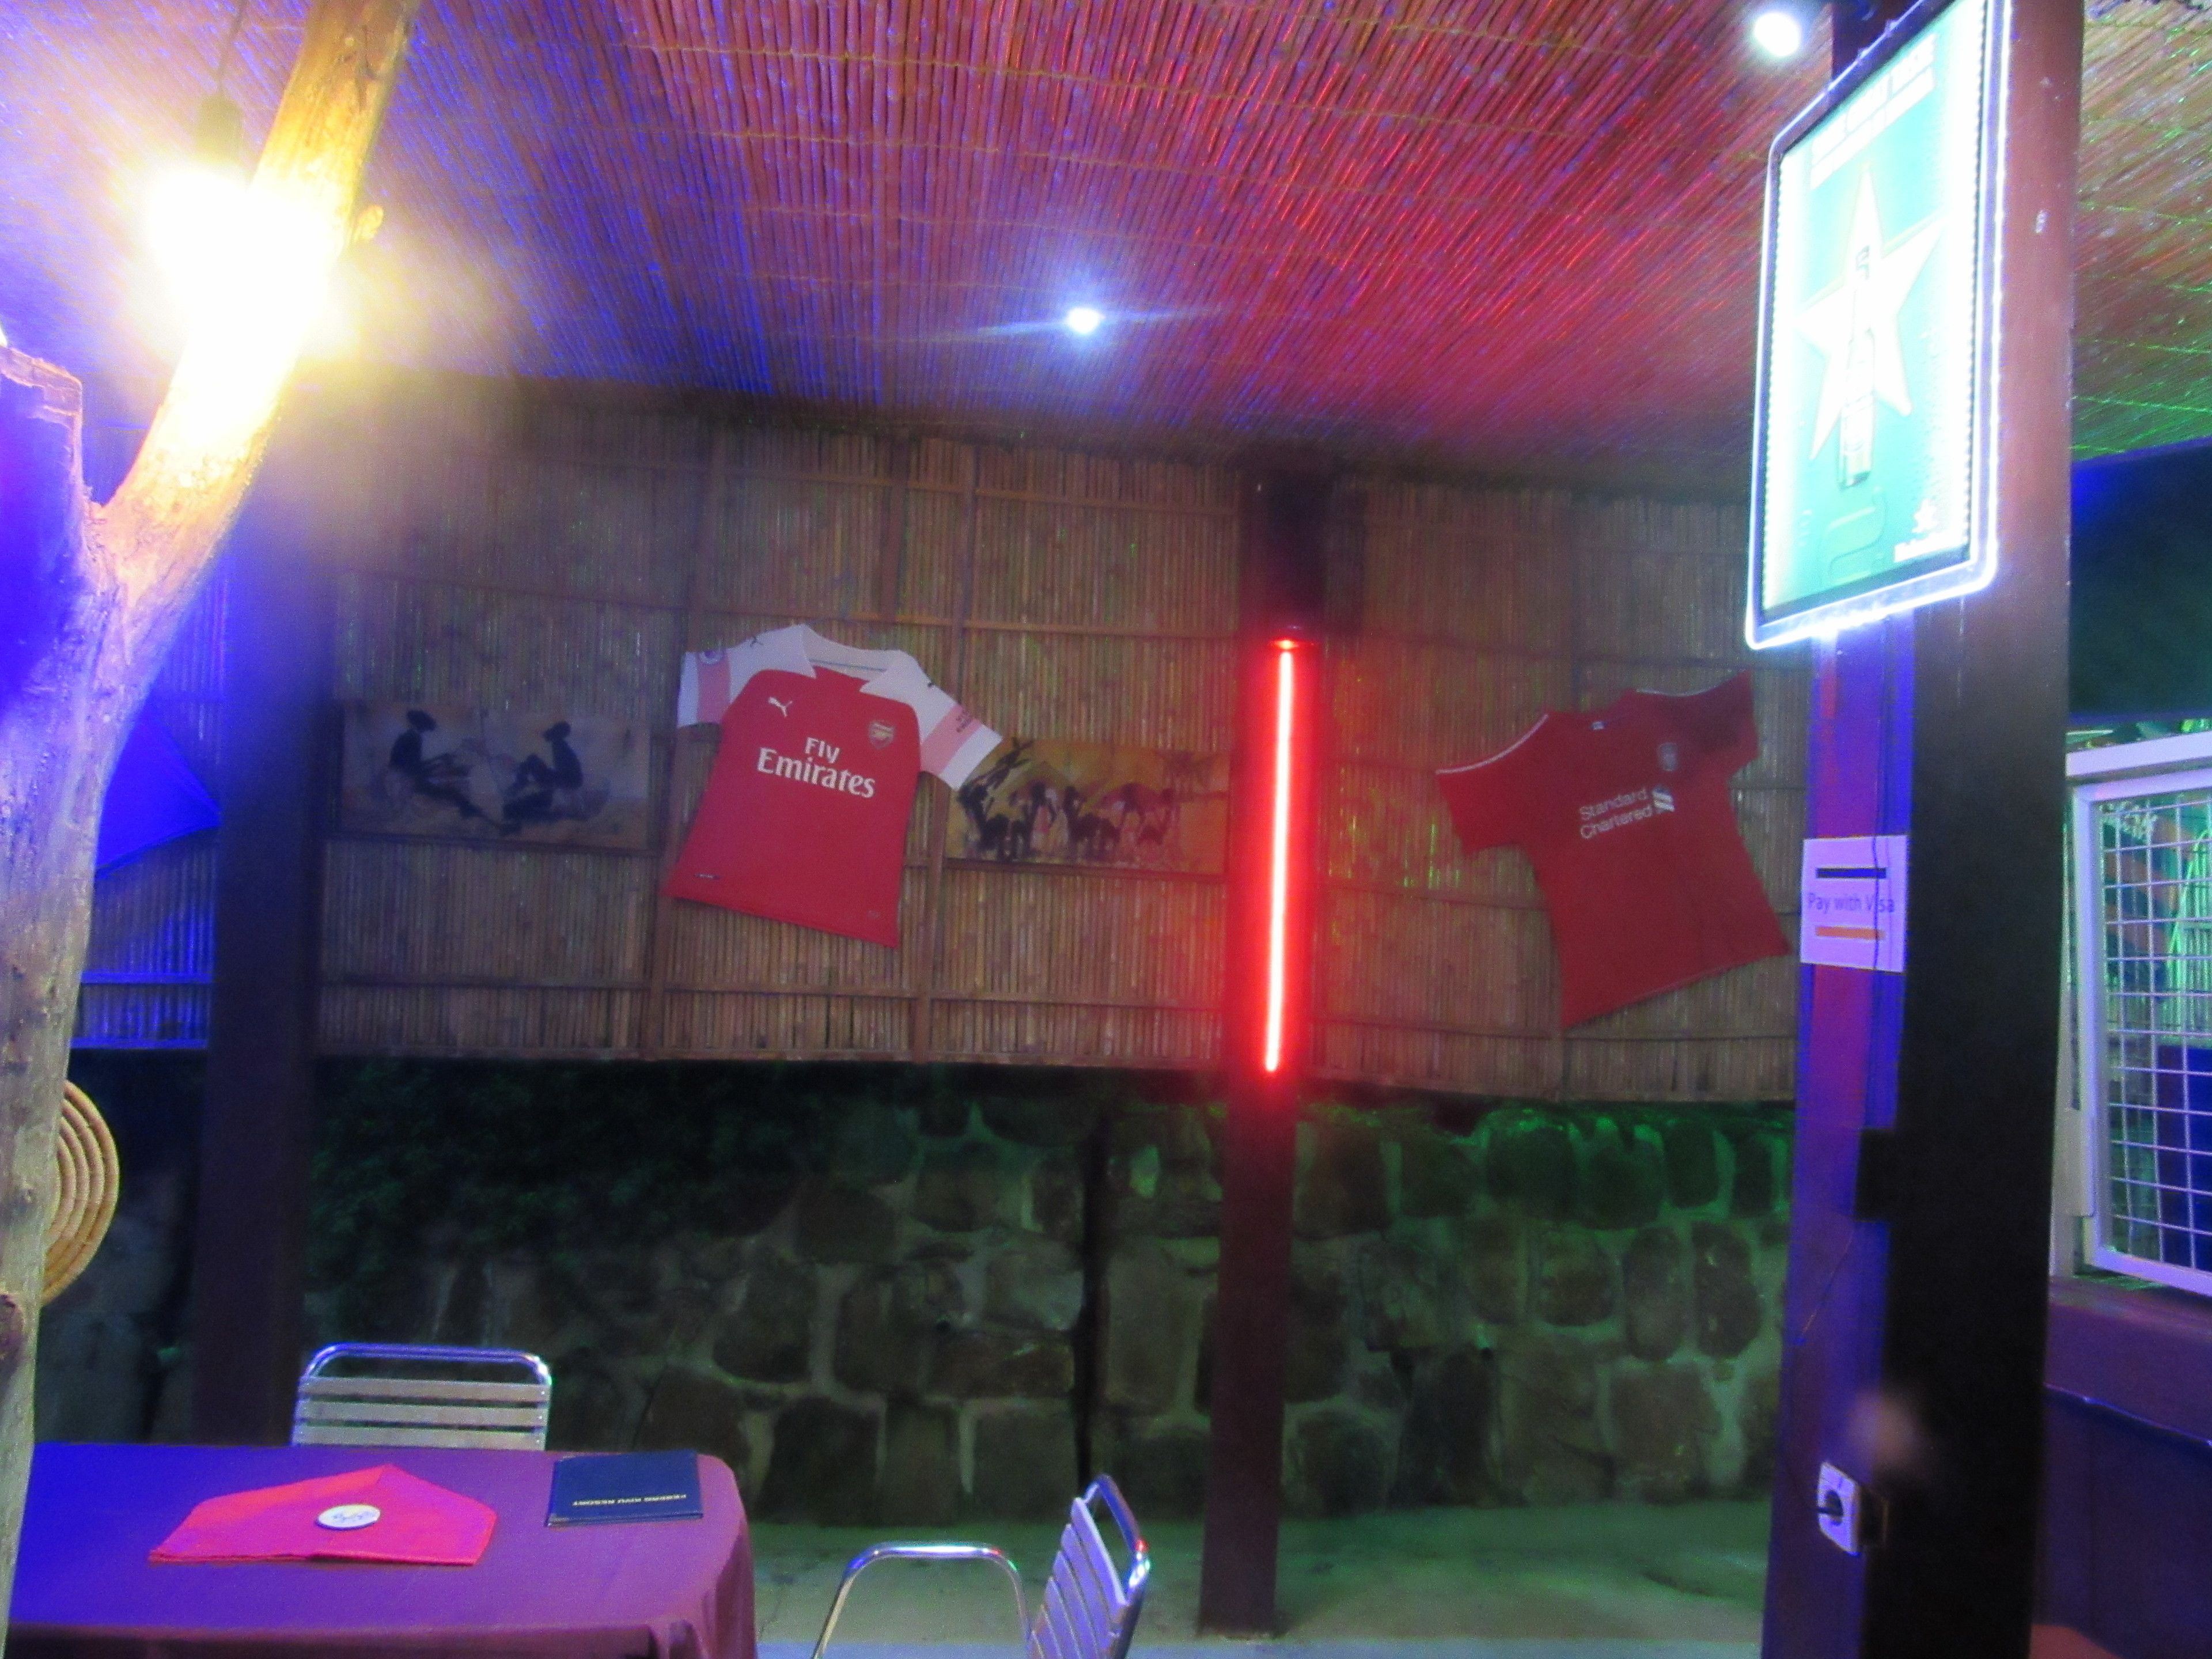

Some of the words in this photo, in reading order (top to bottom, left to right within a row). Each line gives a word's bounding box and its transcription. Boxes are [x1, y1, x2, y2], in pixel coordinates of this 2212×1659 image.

[805, 737, 840, 764] Fly
[757, 747, 875, 798] Emirates
[1580, 789, 1648, 820] Standard
[1580, 805, 1653, 839] Chartered
[1808, 892, 1830, 914] Pay
[1865, 895, 1895, 912] Vsa
